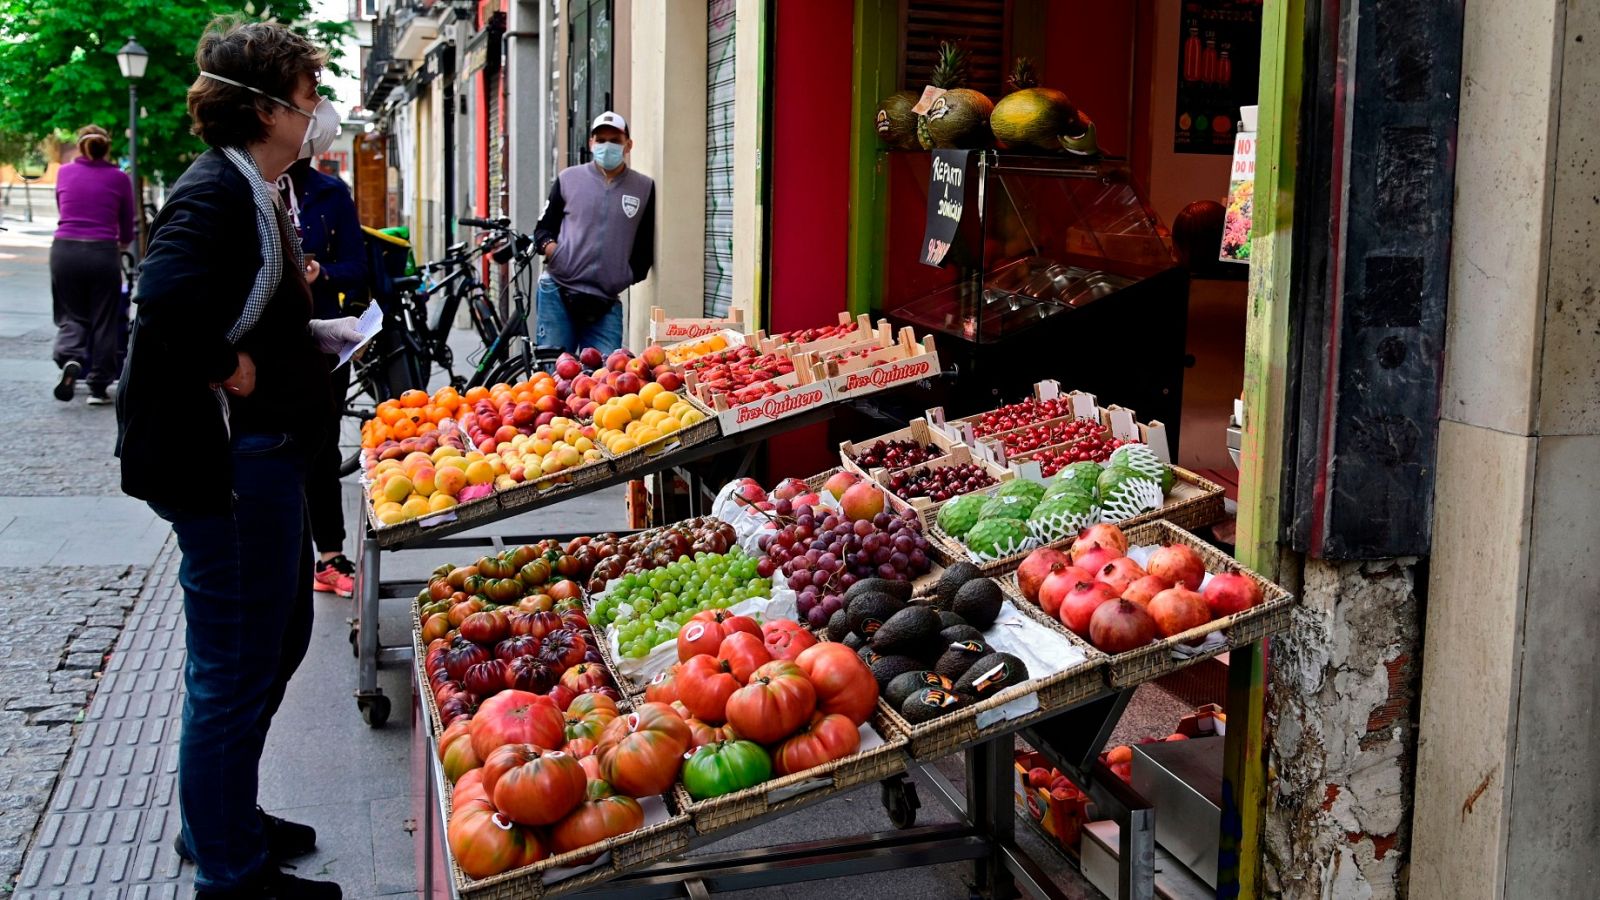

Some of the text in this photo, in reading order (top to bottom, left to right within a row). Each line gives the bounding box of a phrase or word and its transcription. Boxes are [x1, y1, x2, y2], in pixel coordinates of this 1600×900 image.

[1237, 139, 1250, 155] NO
[933, 156, 962, 187] REPARTO
[1235, 160, 1256, 173] DO N
[847, 361, 929, 390] Fres-Quintero
[736, 389, 823, 424] Fres-Quintero
